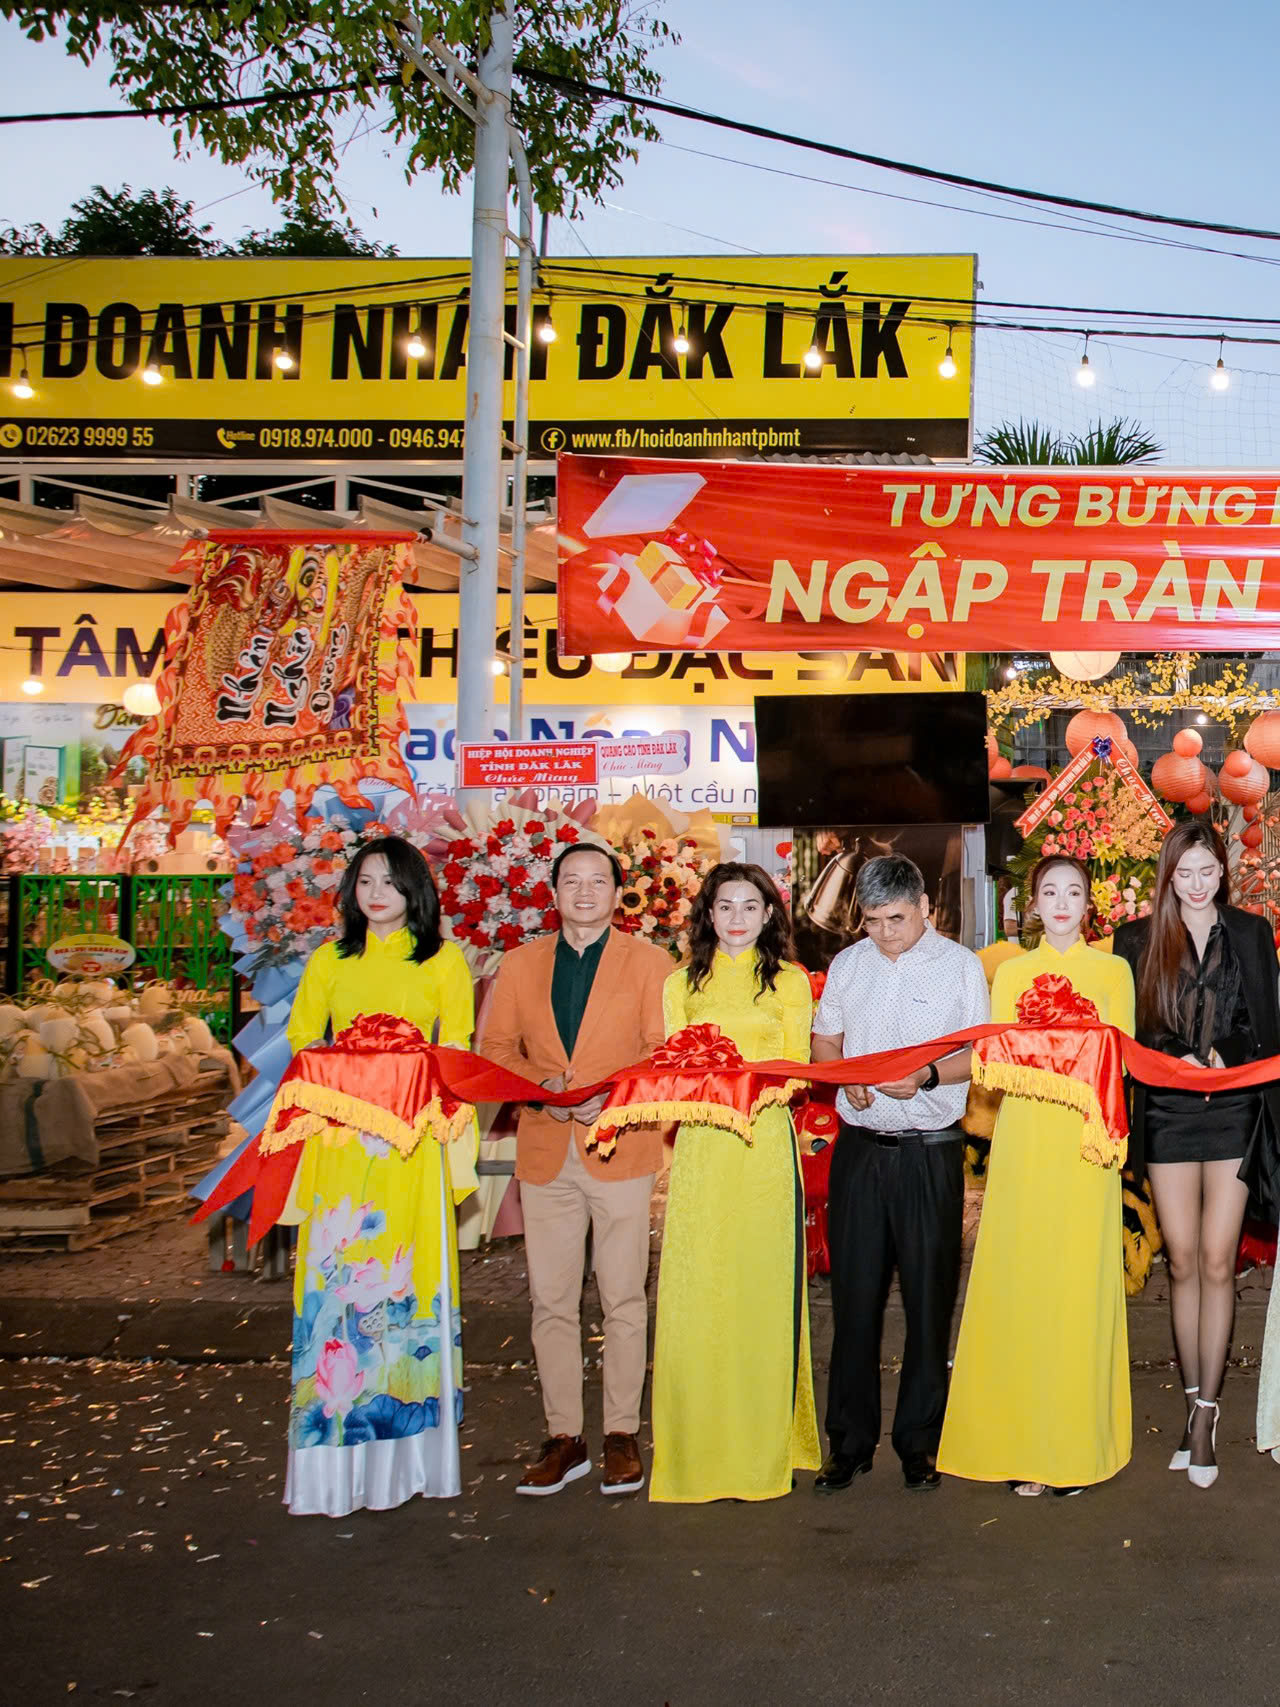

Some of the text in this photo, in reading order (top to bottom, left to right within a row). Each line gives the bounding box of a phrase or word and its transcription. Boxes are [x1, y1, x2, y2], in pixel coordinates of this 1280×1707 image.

[42, 302, 304, 380] DOANH
[576, 272, 735, 380] ĐẮK
[763, 270, 911, 379] LẮK
[26, 426, 155, 447] 02623 9999 55
[260, 428, 373, 448] 0918.974.000
[571, 427, 801, 450] www.fb/hoidoanhnhantpbmt
[882, 483, 1065, 528] TƯNG
[1074, 476, 1266, 528] BỪNG
[766, 541, 1010, 639] NGẬP
[1032, 540, 1266, 623] TRÀN
[14, 614, 166, 678] TÂM
[691, 780, 734, 803] cầu
